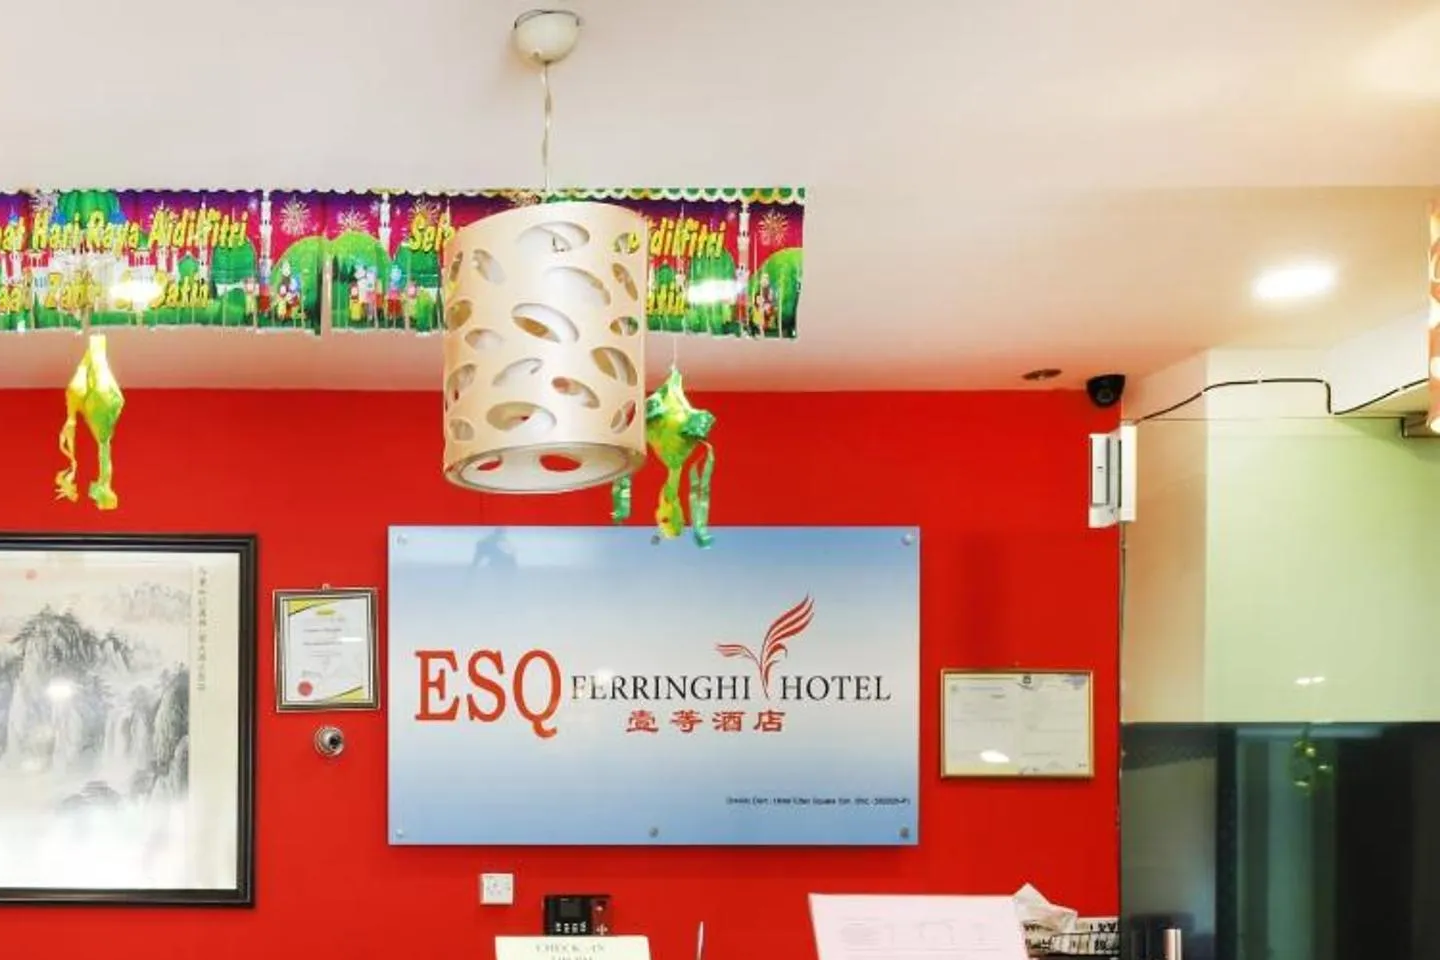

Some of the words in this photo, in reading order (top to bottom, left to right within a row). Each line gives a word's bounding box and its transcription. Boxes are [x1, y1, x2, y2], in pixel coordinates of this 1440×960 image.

[32, 208, 80, 251] Hari
[86, 210, 140, 261] Raya
[414, 648, 563, 739] ESQ
[571, 673, 750, 701] FERRINGHI
[780, 674, 892, 702] HOTEL
